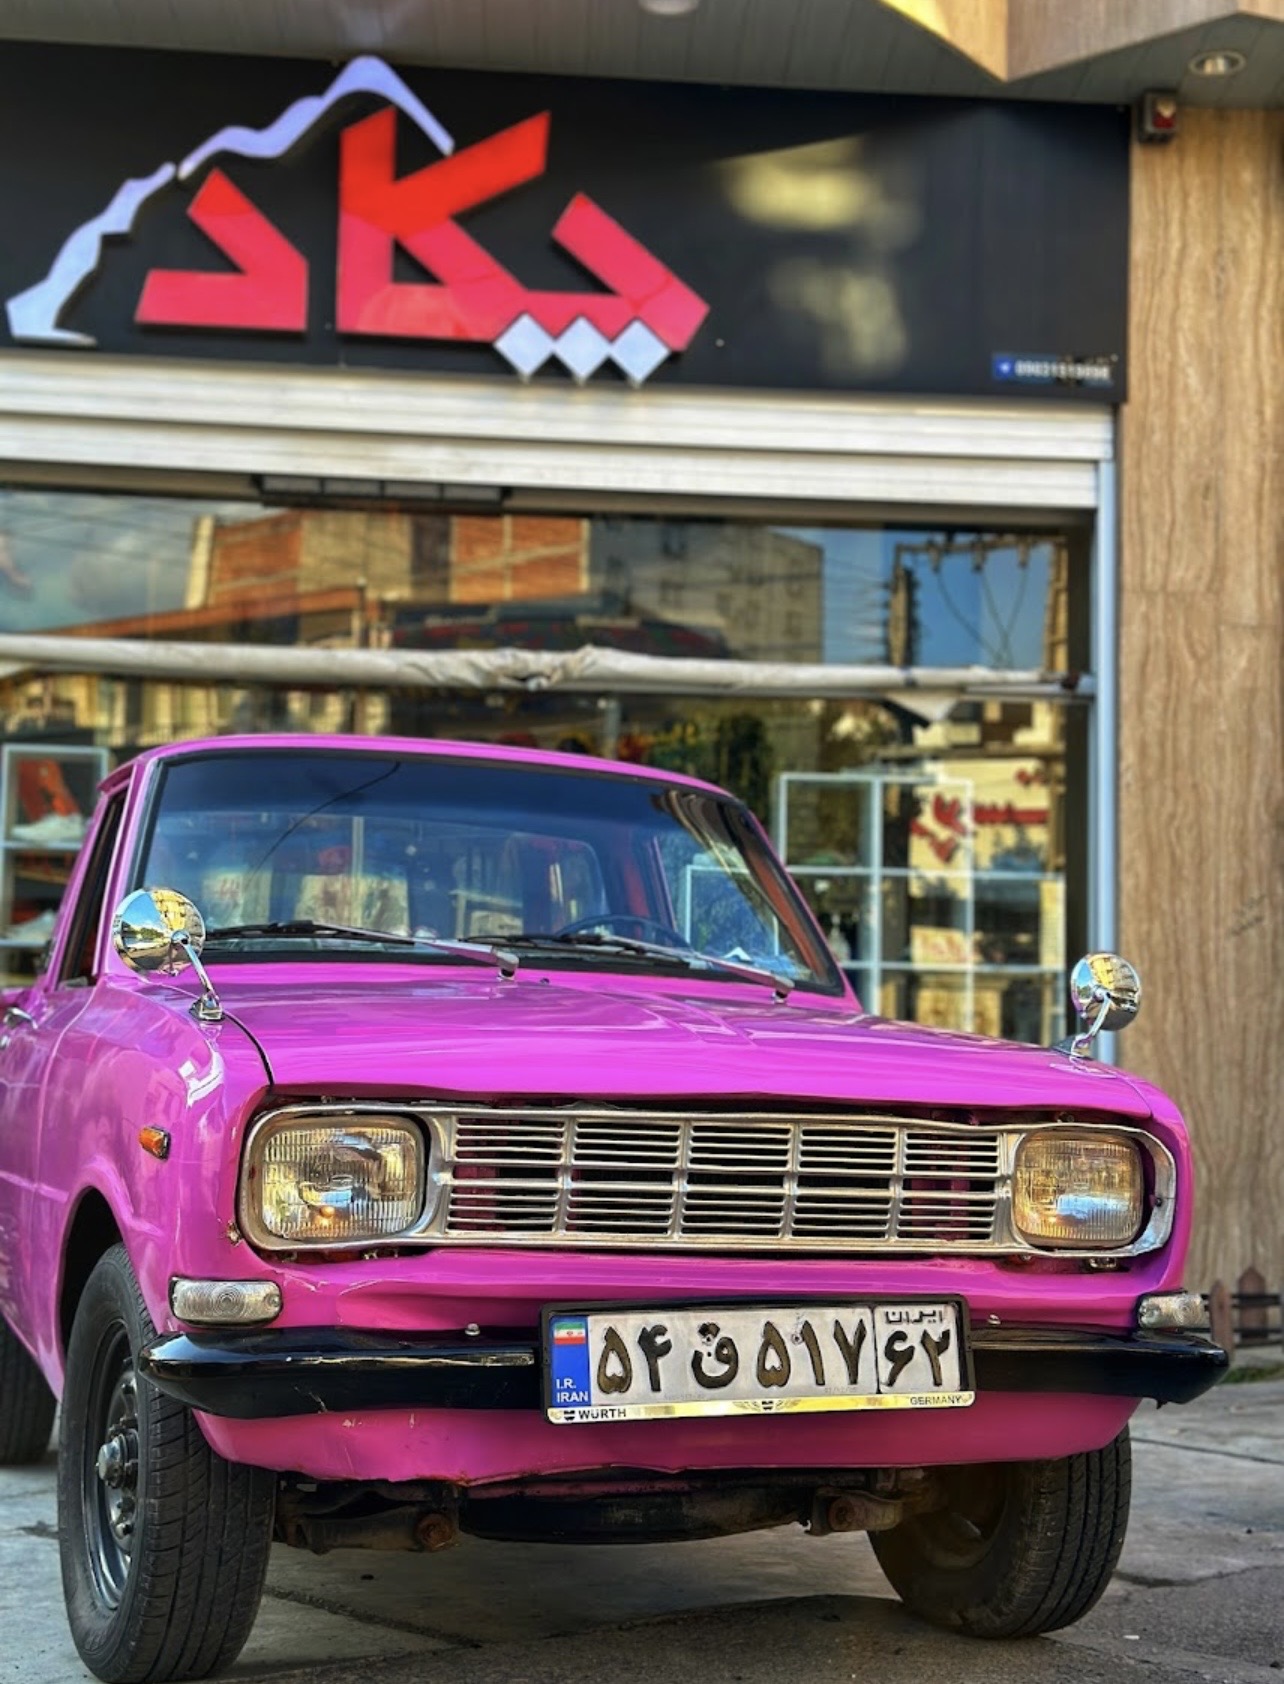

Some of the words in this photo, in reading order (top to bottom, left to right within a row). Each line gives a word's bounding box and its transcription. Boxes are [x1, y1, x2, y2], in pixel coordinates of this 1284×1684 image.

[885, 1310, 943, 1324] ایران
[597, 1325, 672, 1395] ۵۴
[690, 1322, 739, 1389] ق
[757, 1319, 867, 1388] ۵۱۷
[884, 1329, 951, 1387] ۶۲
[556, 1378, 577, 1389] I.R.
[556, 1391, 589, 1403] IRAN
[909, 1394, 962, 1406] GERMANY
